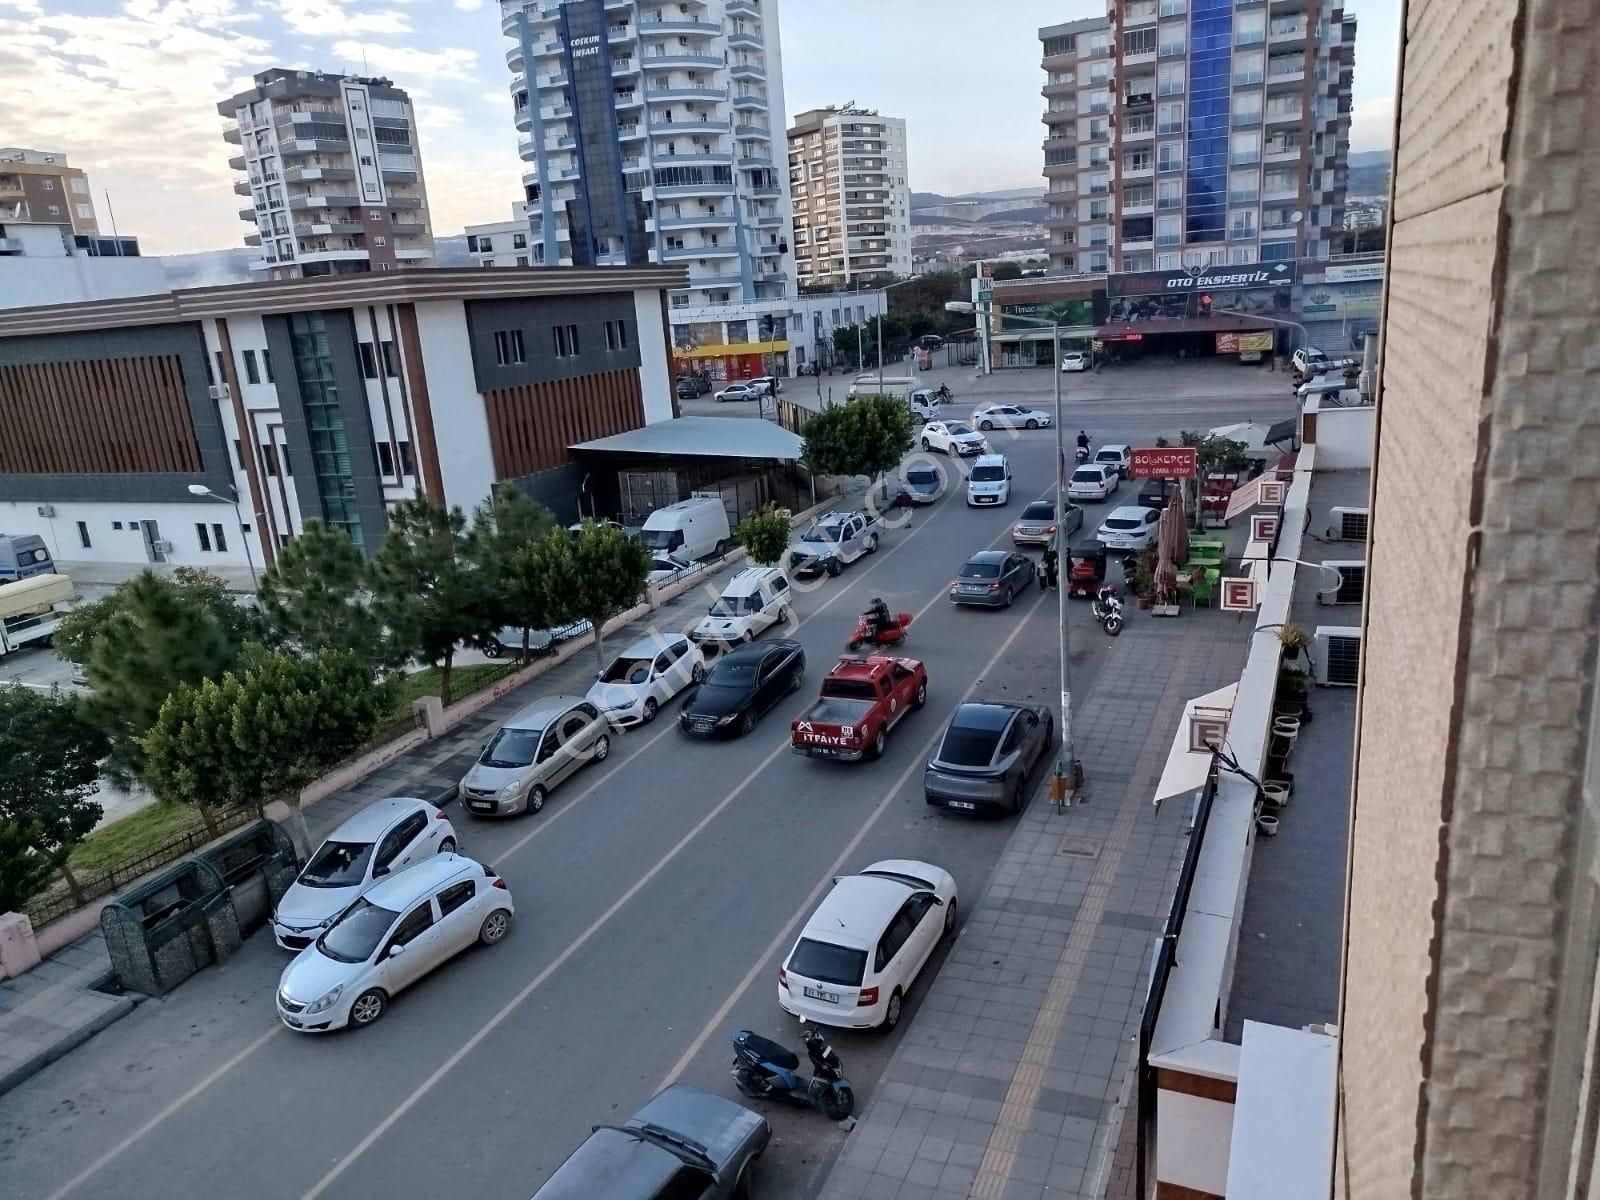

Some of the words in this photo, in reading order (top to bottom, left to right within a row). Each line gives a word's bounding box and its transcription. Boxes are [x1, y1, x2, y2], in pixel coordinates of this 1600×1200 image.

[1166, 278, 1193, 288] OTO
[1196, 271, 1270, 286] EKSPERTİZ
[1265, 486, 1279, 501] E
[1259, 521, 1274, 538] E
[1230, 584, 1248, 605] E
[1198, 724, 1220, 748] E
